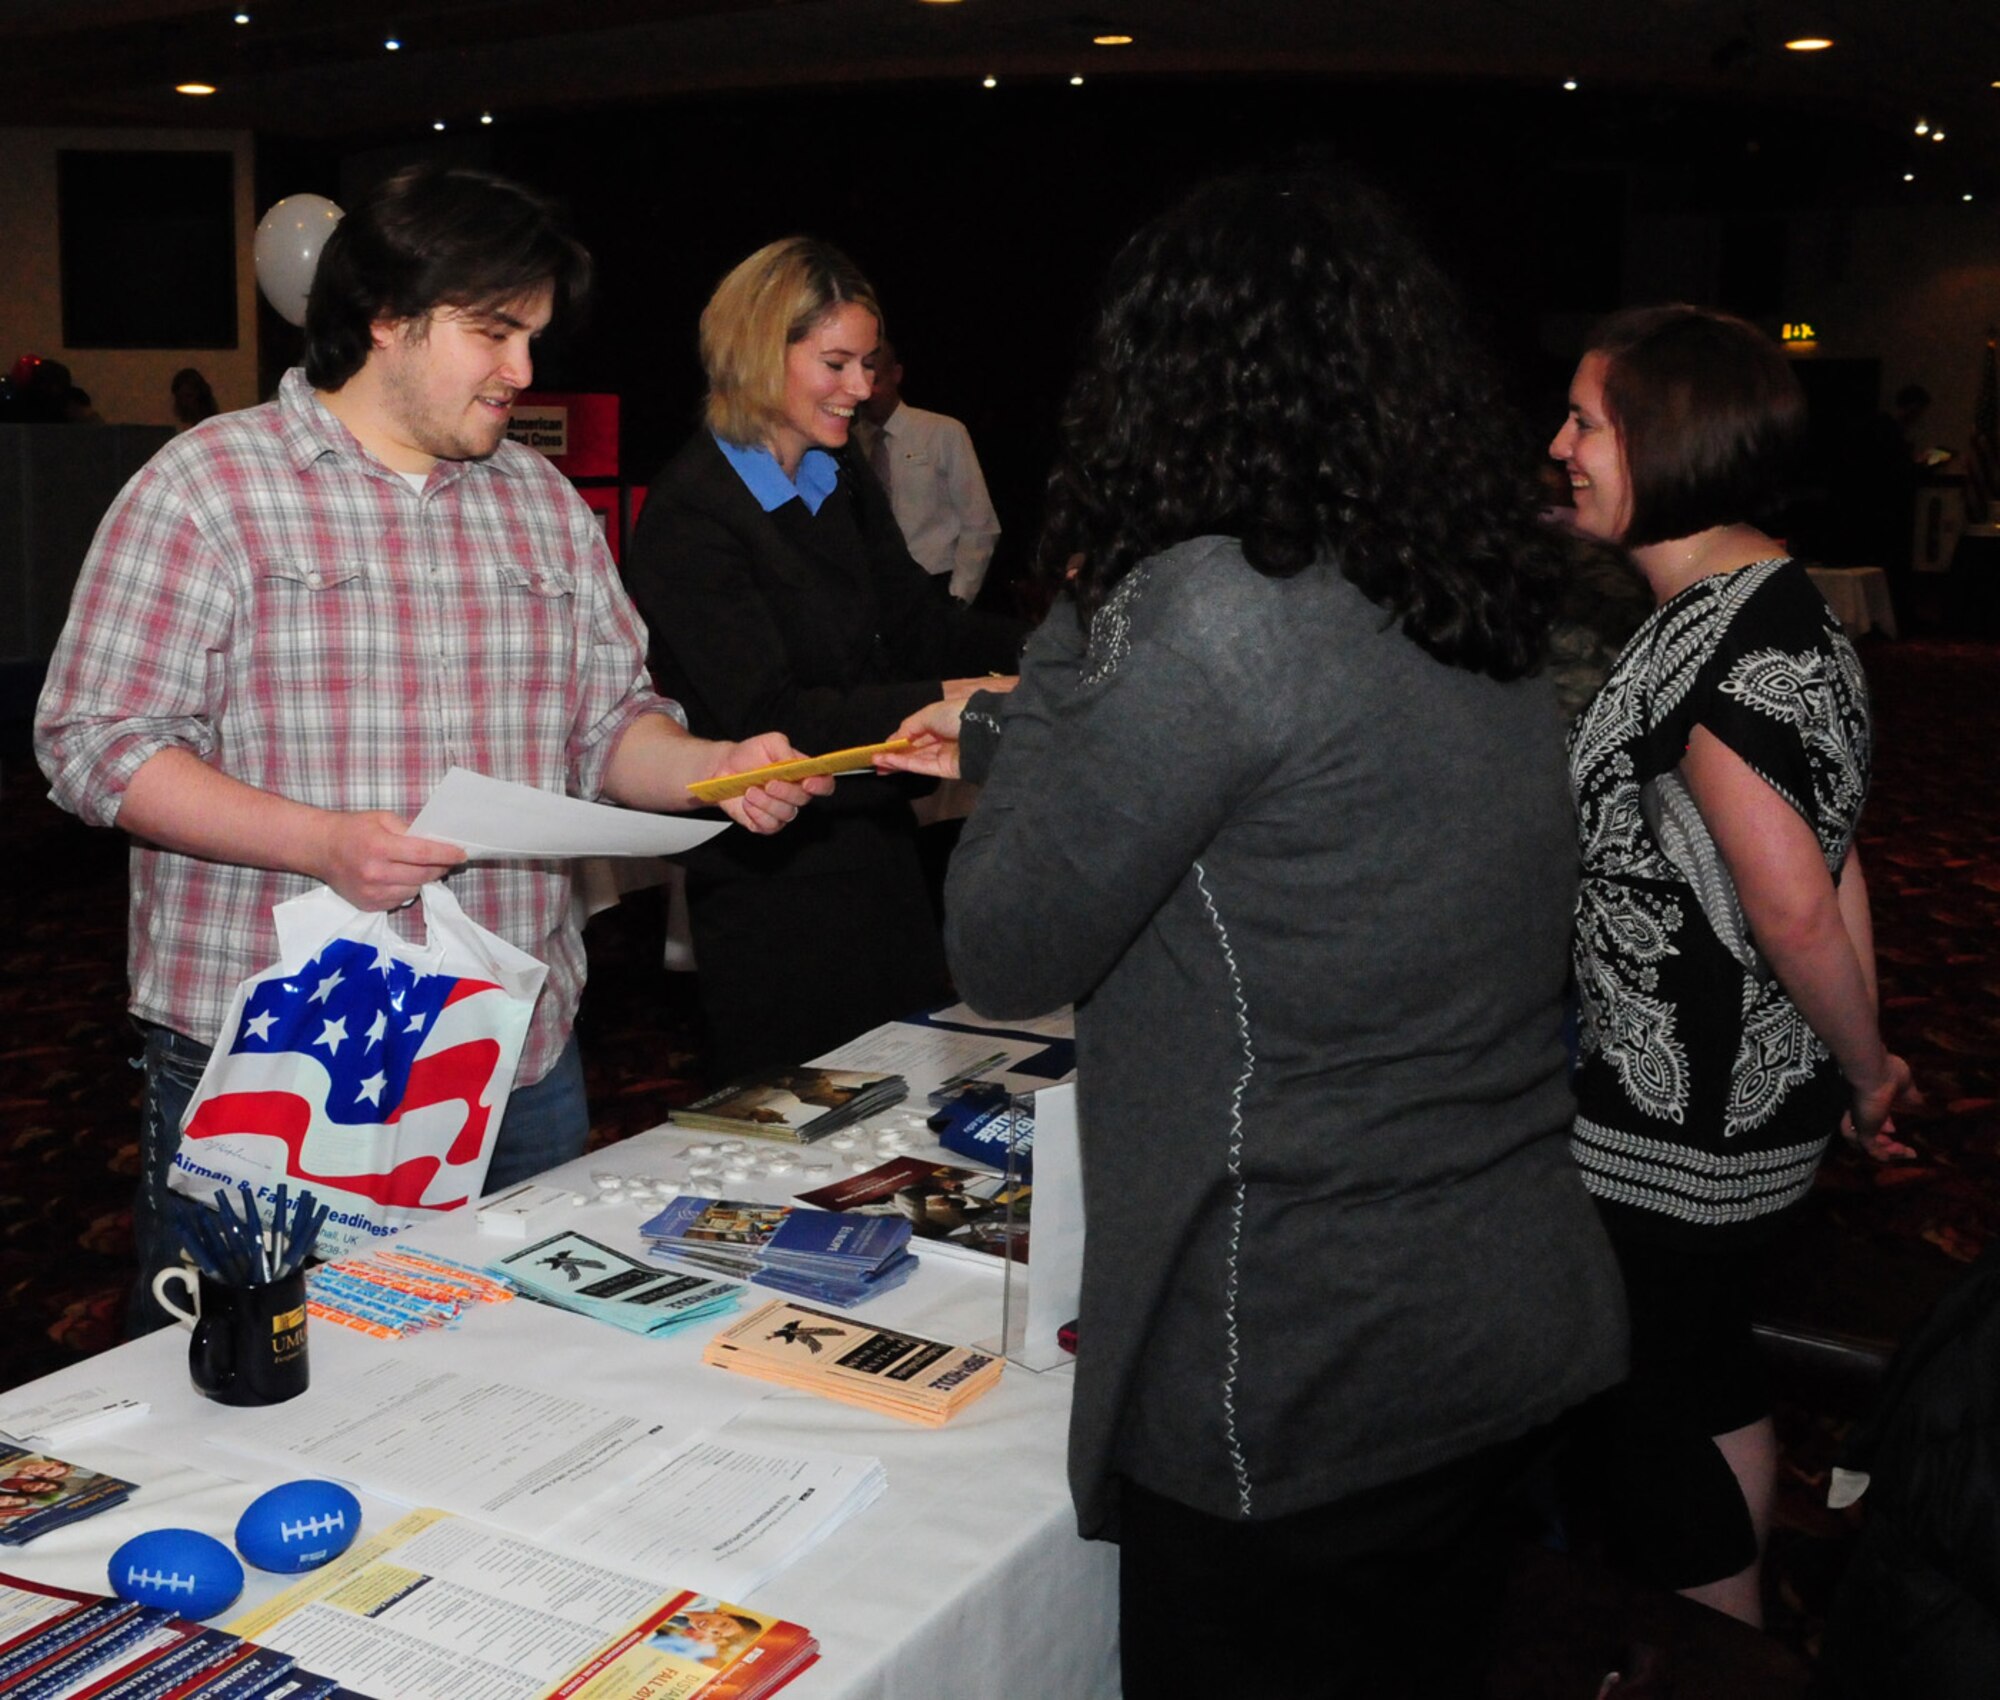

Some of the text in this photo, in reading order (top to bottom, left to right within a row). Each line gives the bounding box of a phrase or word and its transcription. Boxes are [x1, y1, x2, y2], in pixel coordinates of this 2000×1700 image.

[507, 416, 563, 430] American
[531, 432, 563, 447] Cross
[173, 1152, 233, 1186] Airman
[328, 1209, 399, 1237] eadiness
[50, 1605, 103, 1636] ACADEMIC
[92, 1616, 143, 1648] ACADEMIC
[39, 1646, 94, 1679] CALENDAR
[153, 1639, 208, 1672] ACADEMIC
[208, 1658, 262, 1695] ACADEMIC
[647, 1667, 679, 1687] FALL
[659, 1674, 700, 1700] DISTA
